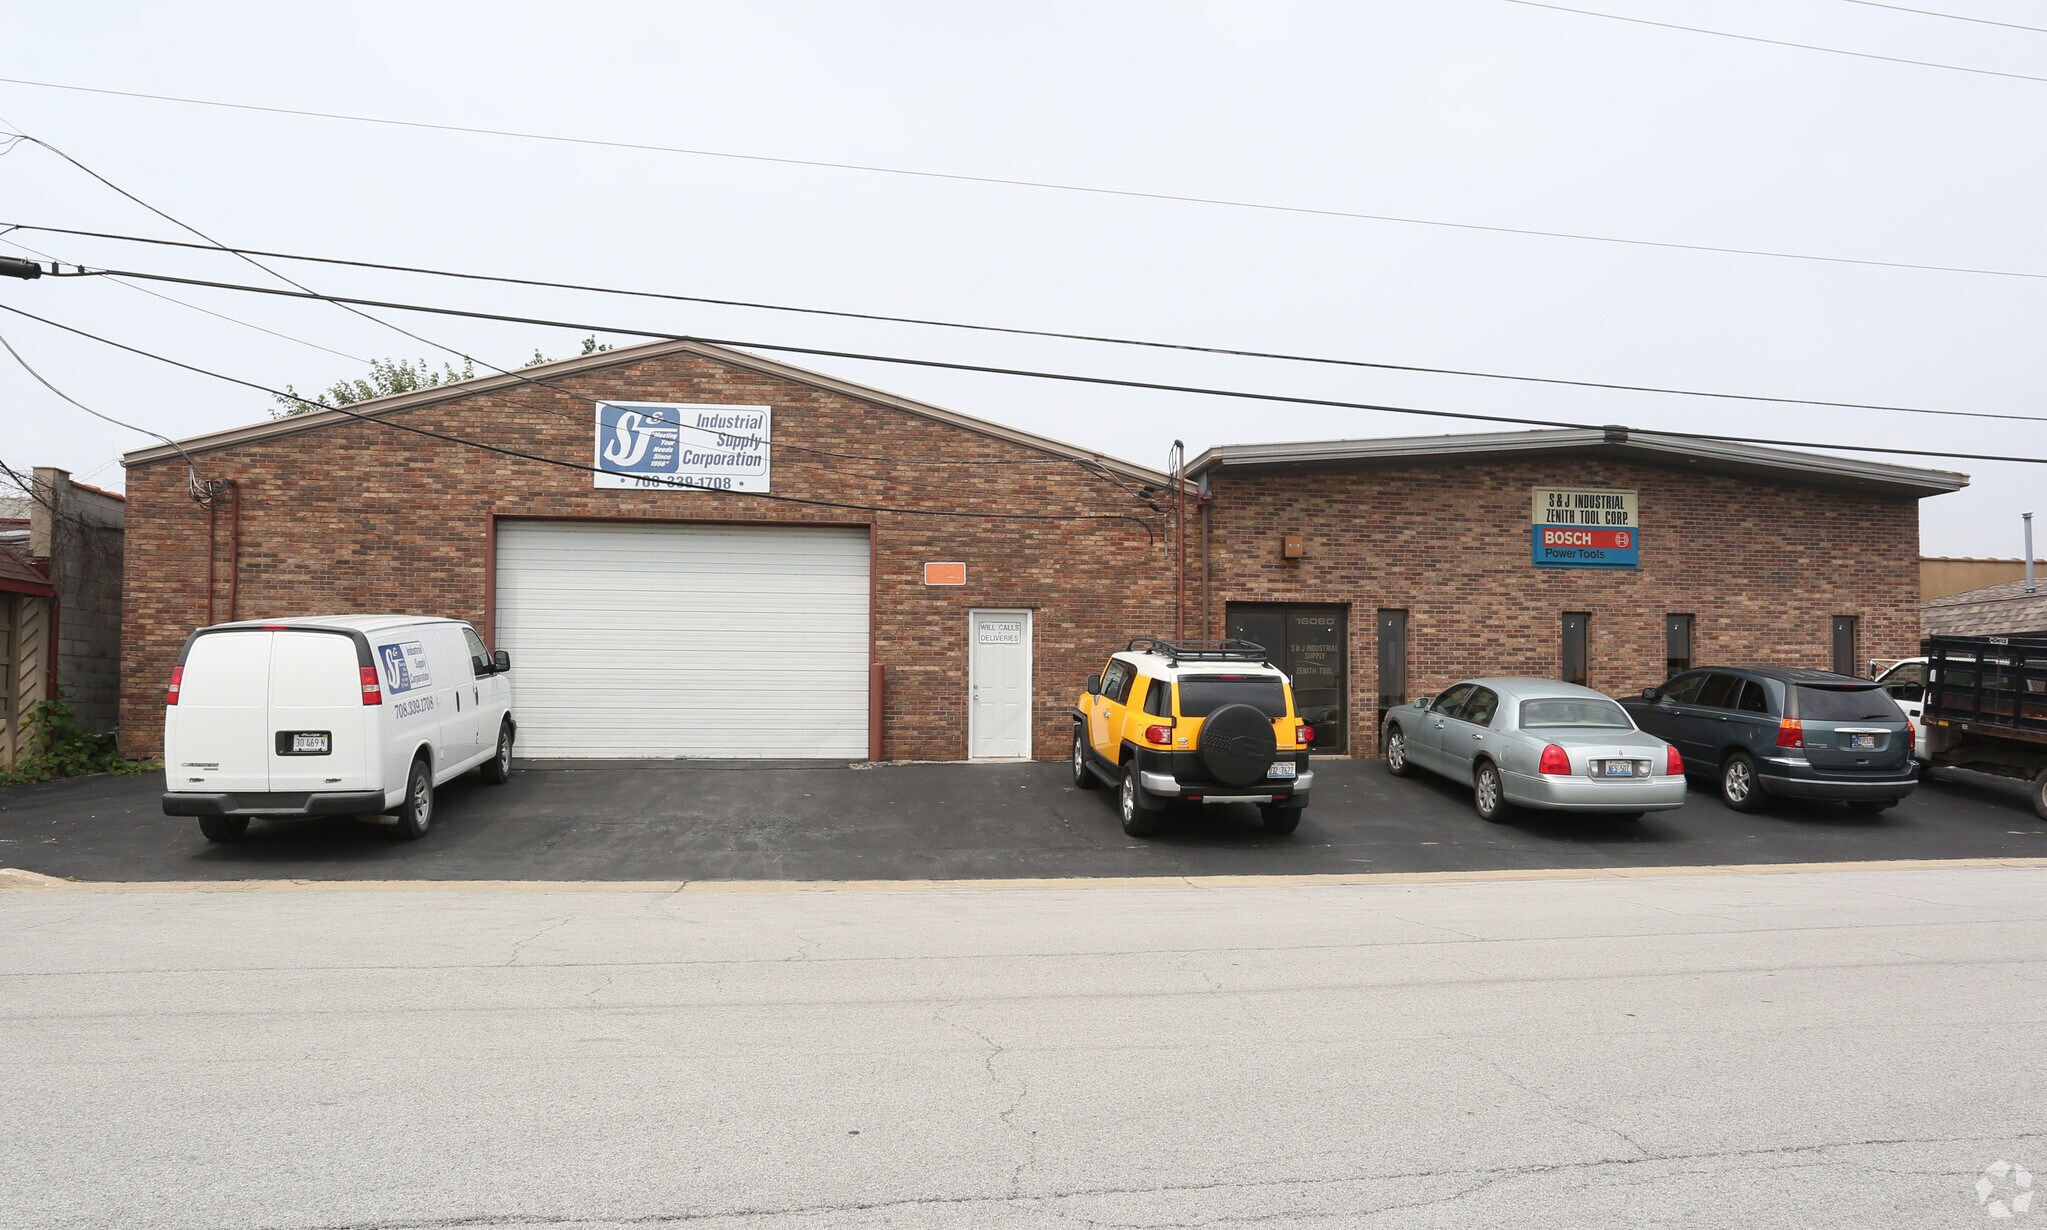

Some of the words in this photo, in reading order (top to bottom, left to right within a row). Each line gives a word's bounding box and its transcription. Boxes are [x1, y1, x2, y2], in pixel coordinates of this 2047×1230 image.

[696, 413, 763, 430] Industrial
[716, 432, 762, 451] Supply
[682, 449, 762, 469] Corporation
[634, 475, 732, 490] 708-339-1708
[1549, 493, 1555, 507] S
[1556, 494, 1562, 508] &
[1565, 494, 1570, 508] J
[1575, 494, 1624, 510] INDUSTRIAL
[1546, 509, 1575, 523] ZENITH
[1580, 510, 1600, 525] TOOL
[1605, 511, 1628, 525] CORP.
[1545, 531, 1592, 545] BOSCH
[1545, 548, 1576, 558] Power
[1578, 549, 1605, 559] Tools
[1296, 617, 1335, 625] 16060
[1306, 644, 1338, 652] INDUSTRIAL
[1304, 652, 1326, 660] SUPPLY
[1296, 667, 1317, 675] ZENITH
[1319, 667, 1333, 675] TOOL
[394, 695, 435, 719] 708.339.1708
